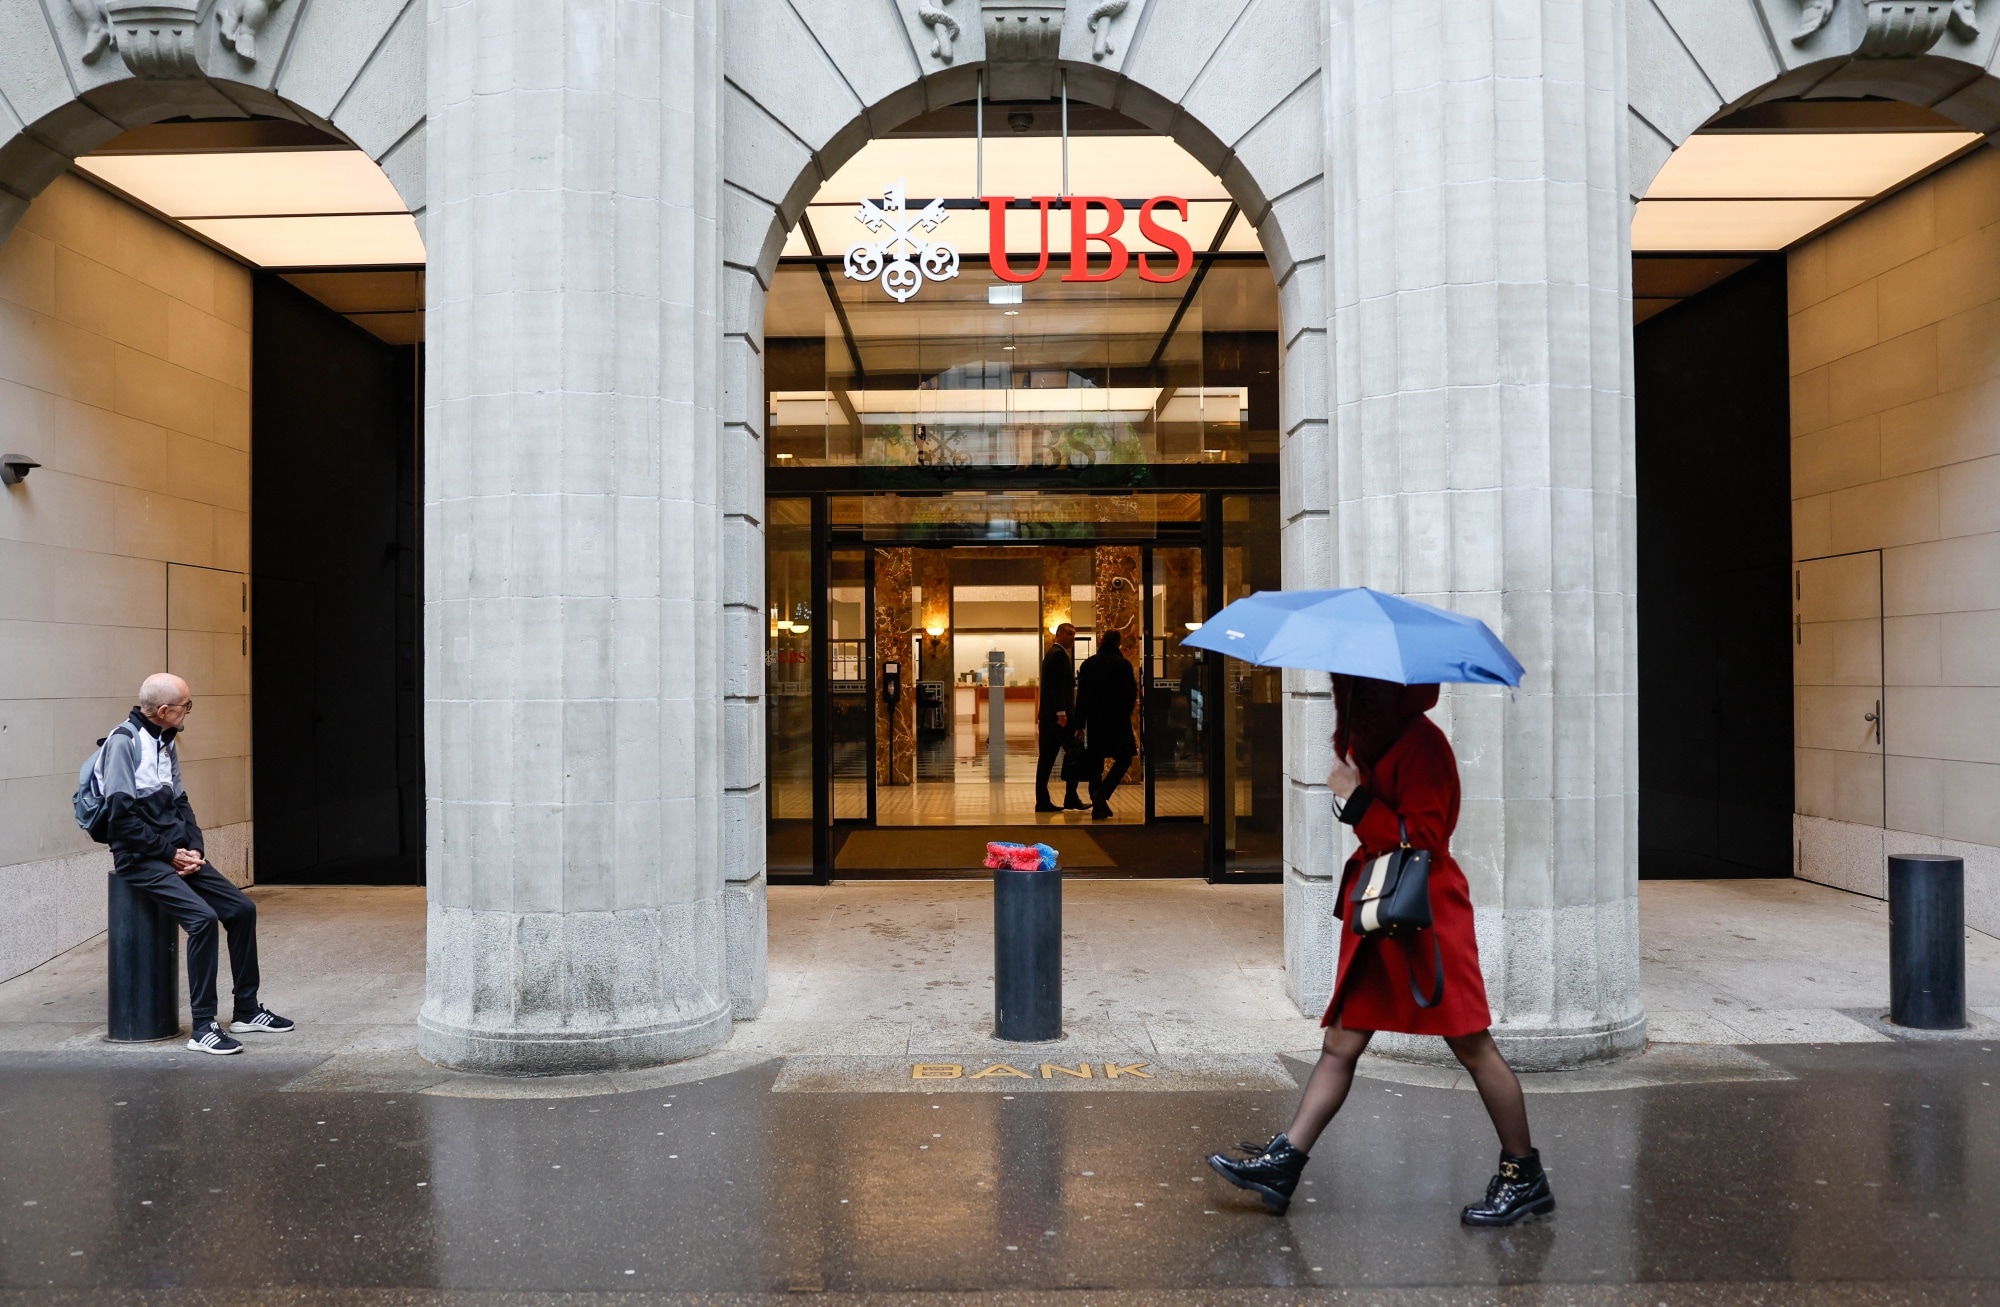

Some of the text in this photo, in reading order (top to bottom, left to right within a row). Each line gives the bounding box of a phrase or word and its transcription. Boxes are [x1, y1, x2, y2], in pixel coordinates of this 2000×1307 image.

[980, 195, 1195, 283] UBS
[778, 651, 807, 664] UBS
[911, 1063, 1154, 1079] BANK
